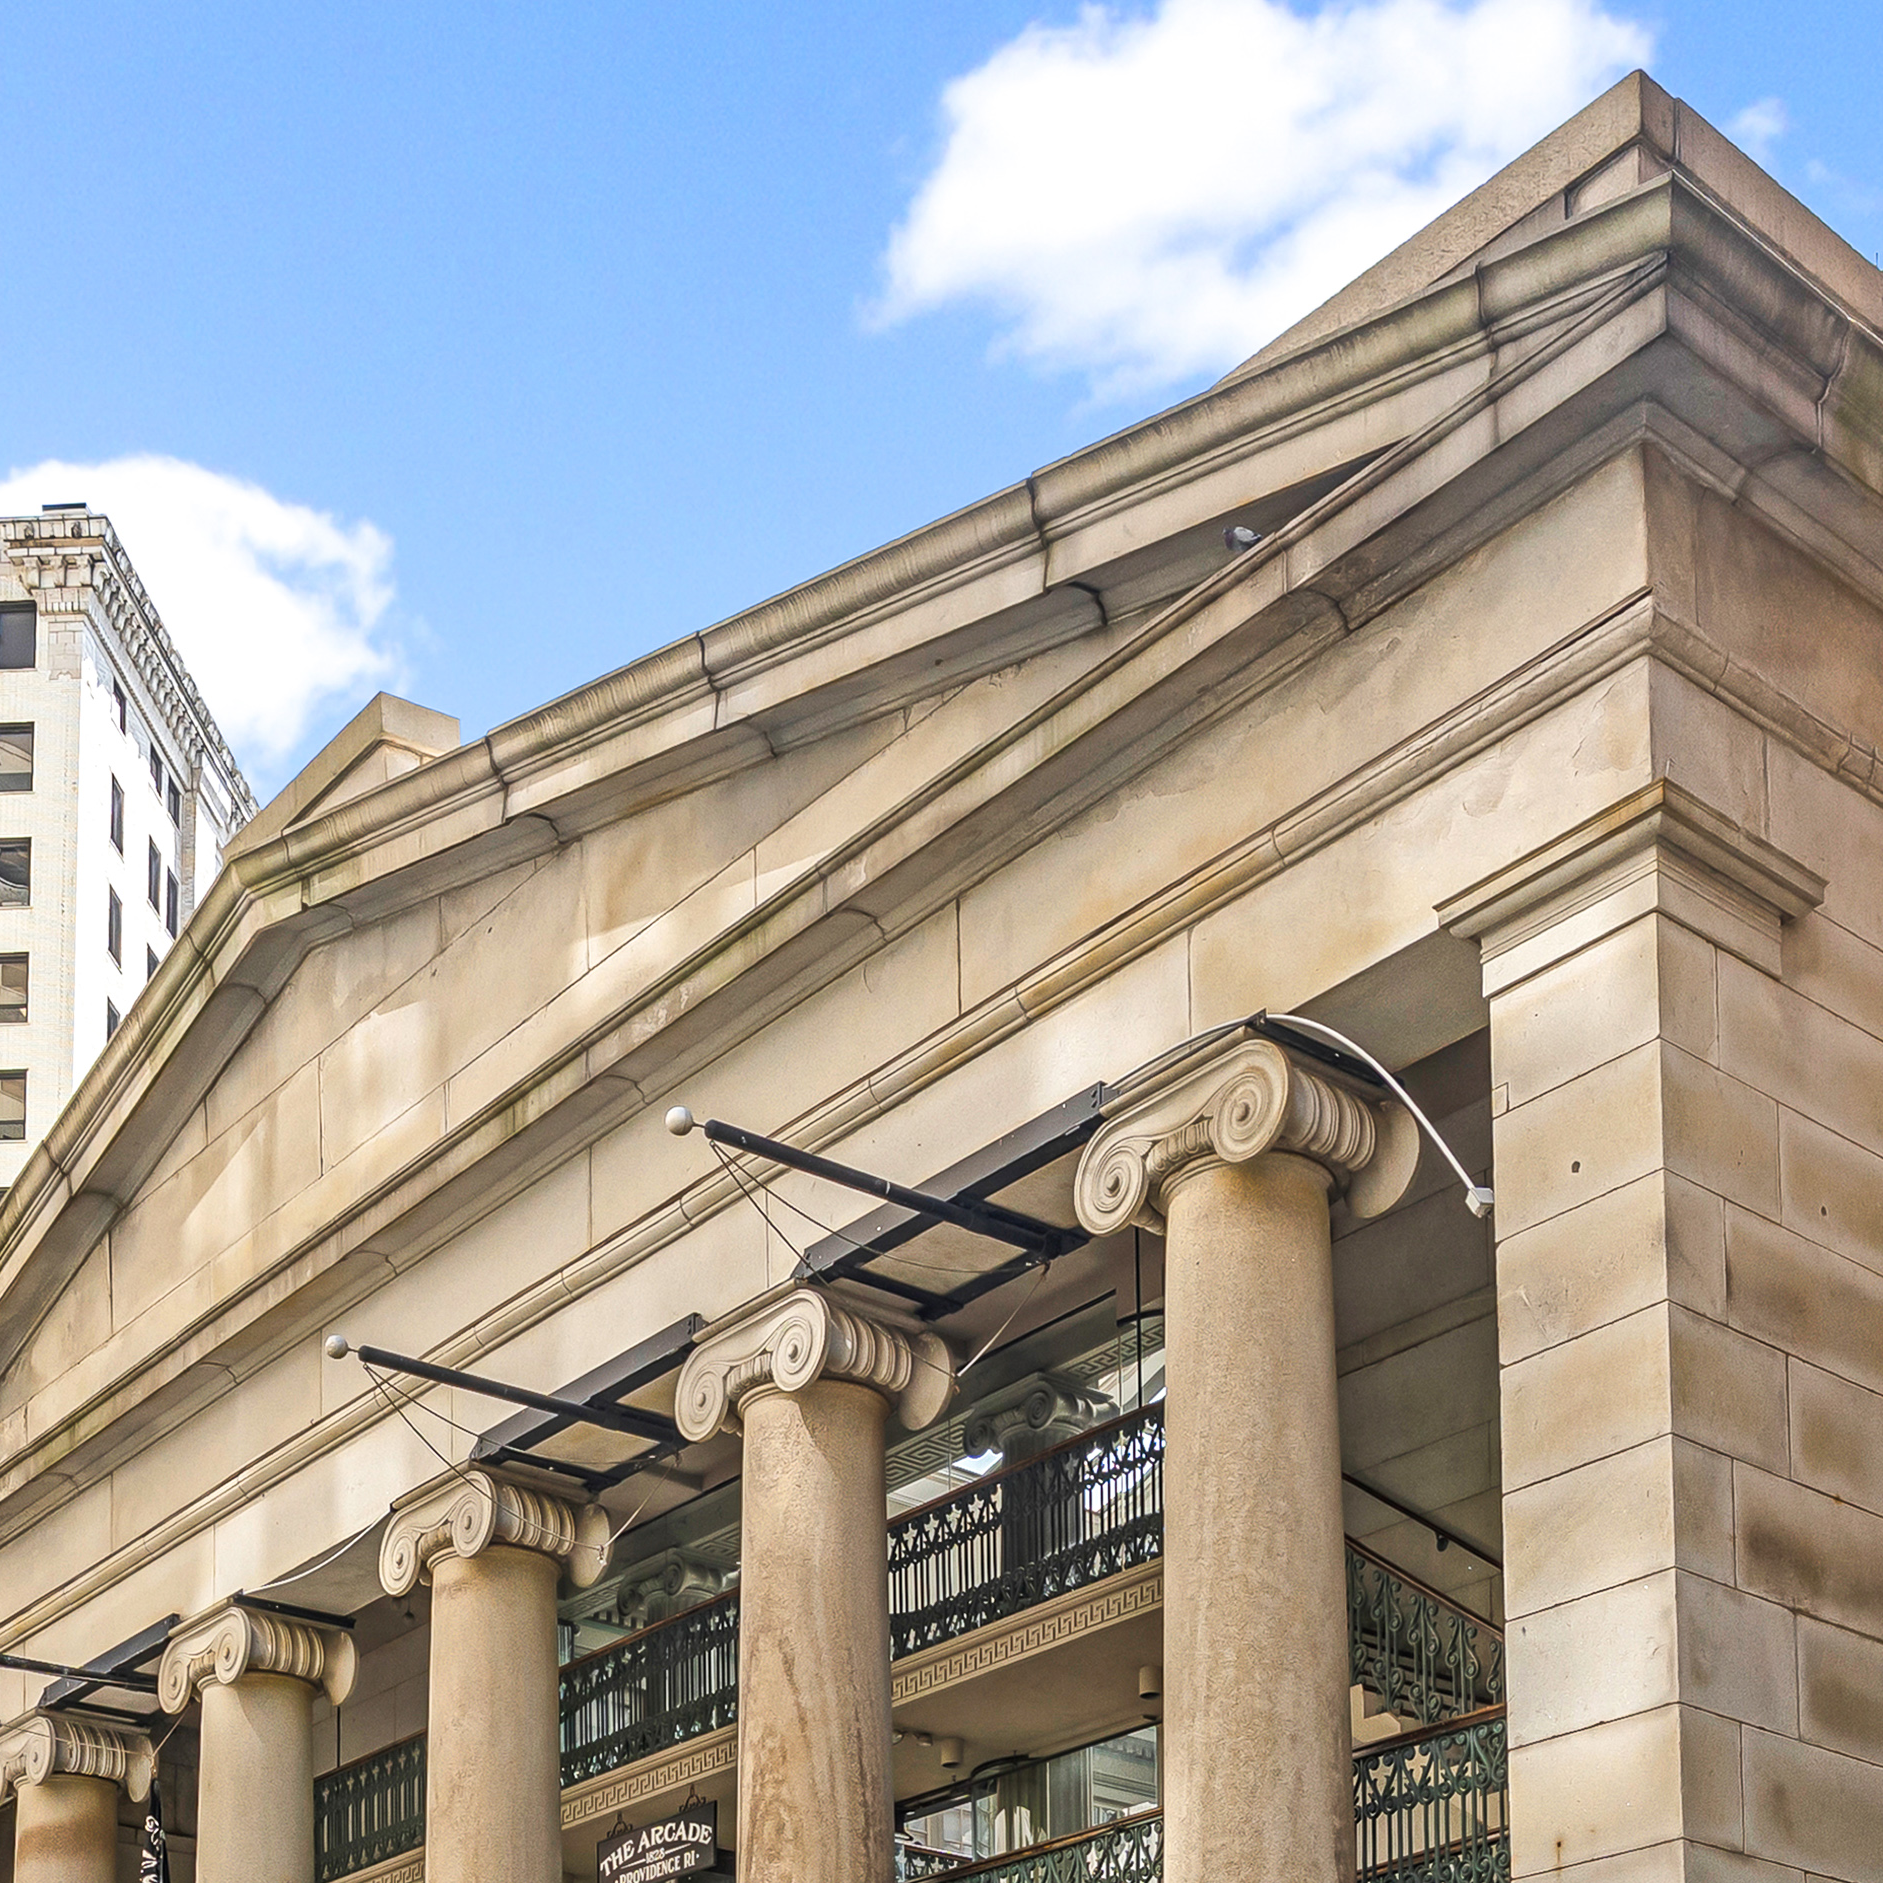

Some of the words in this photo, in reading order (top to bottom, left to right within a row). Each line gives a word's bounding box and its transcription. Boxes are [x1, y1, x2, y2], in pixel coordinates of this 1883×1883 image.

[600, 1839, 635, 1877] THE
[637, 1820, 713, 1854] ARCADE
[683, 1850, 696, 1869] RI
